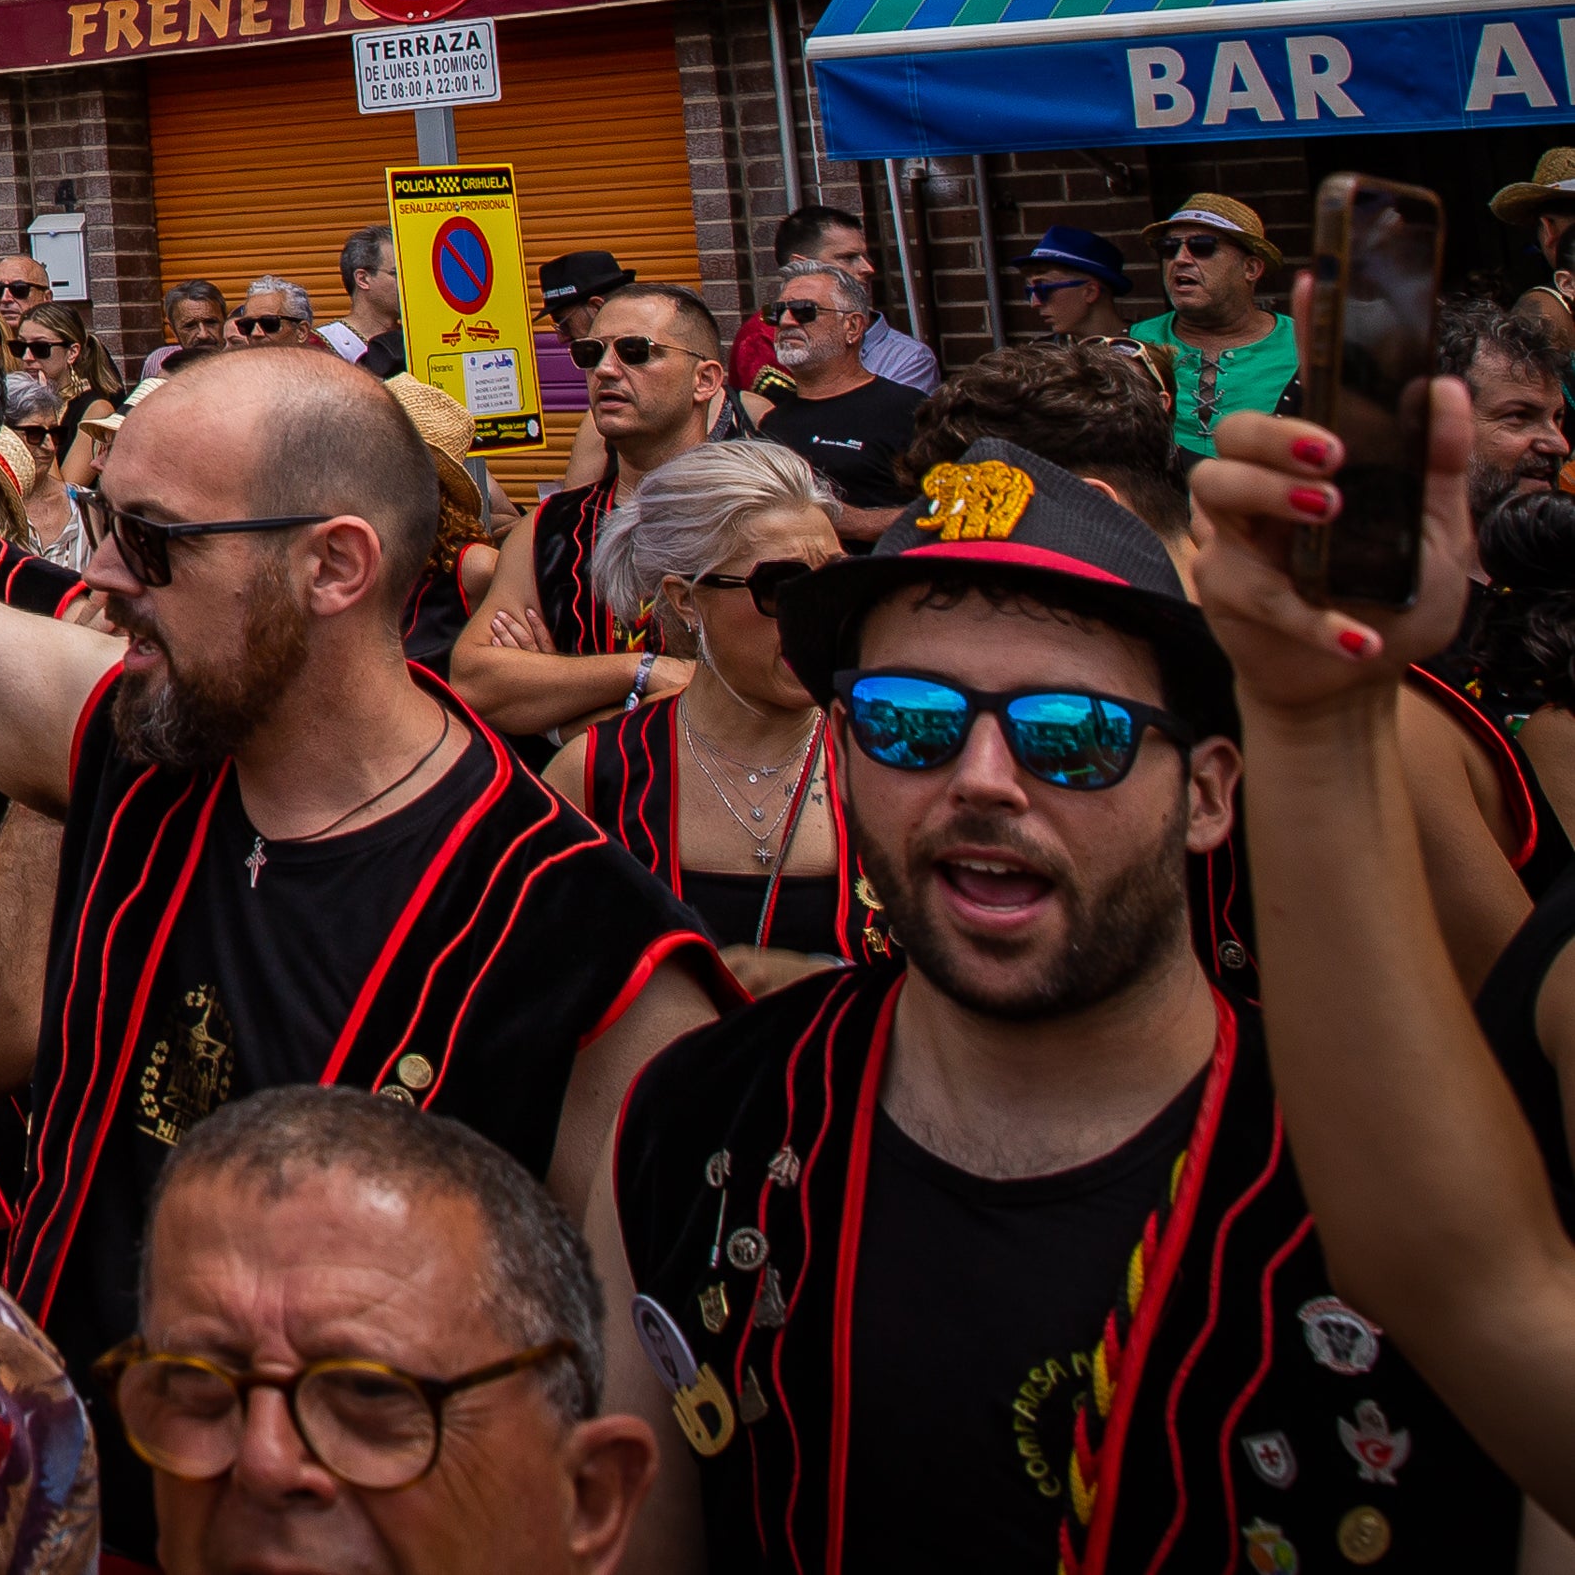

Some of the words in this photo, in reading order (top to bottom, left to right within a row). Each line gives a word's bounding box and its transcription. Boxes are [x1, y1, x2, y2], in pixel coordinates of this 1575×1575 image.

[367, 30, 482, 62] TERRAZA
[365, 65, 380, 82] DE
[383, 60, 419, 81] LUNES
[423, 59, 431, 76] A
[433, 52, 488, 75] DOMINGO
[1126, 34, 1364, 130] BAR
[371, 84, 387, 101] DE
[391, 80, 422, 99] 08:00
[425, 78, 434, 95] A
[437, 76, 468, 94] 22:00
[472, 74, 485, 92] H.
[395, 176, 435, 193] POLICÍA
[462, 176, 510, 190] ORIHUELA
[399, 201, 457, 215] SEÑALIZACIÓN
[461, 198, 511, 212] PROVISIONAL
[1013, 1358, 1068, 1498] COMPARSA
